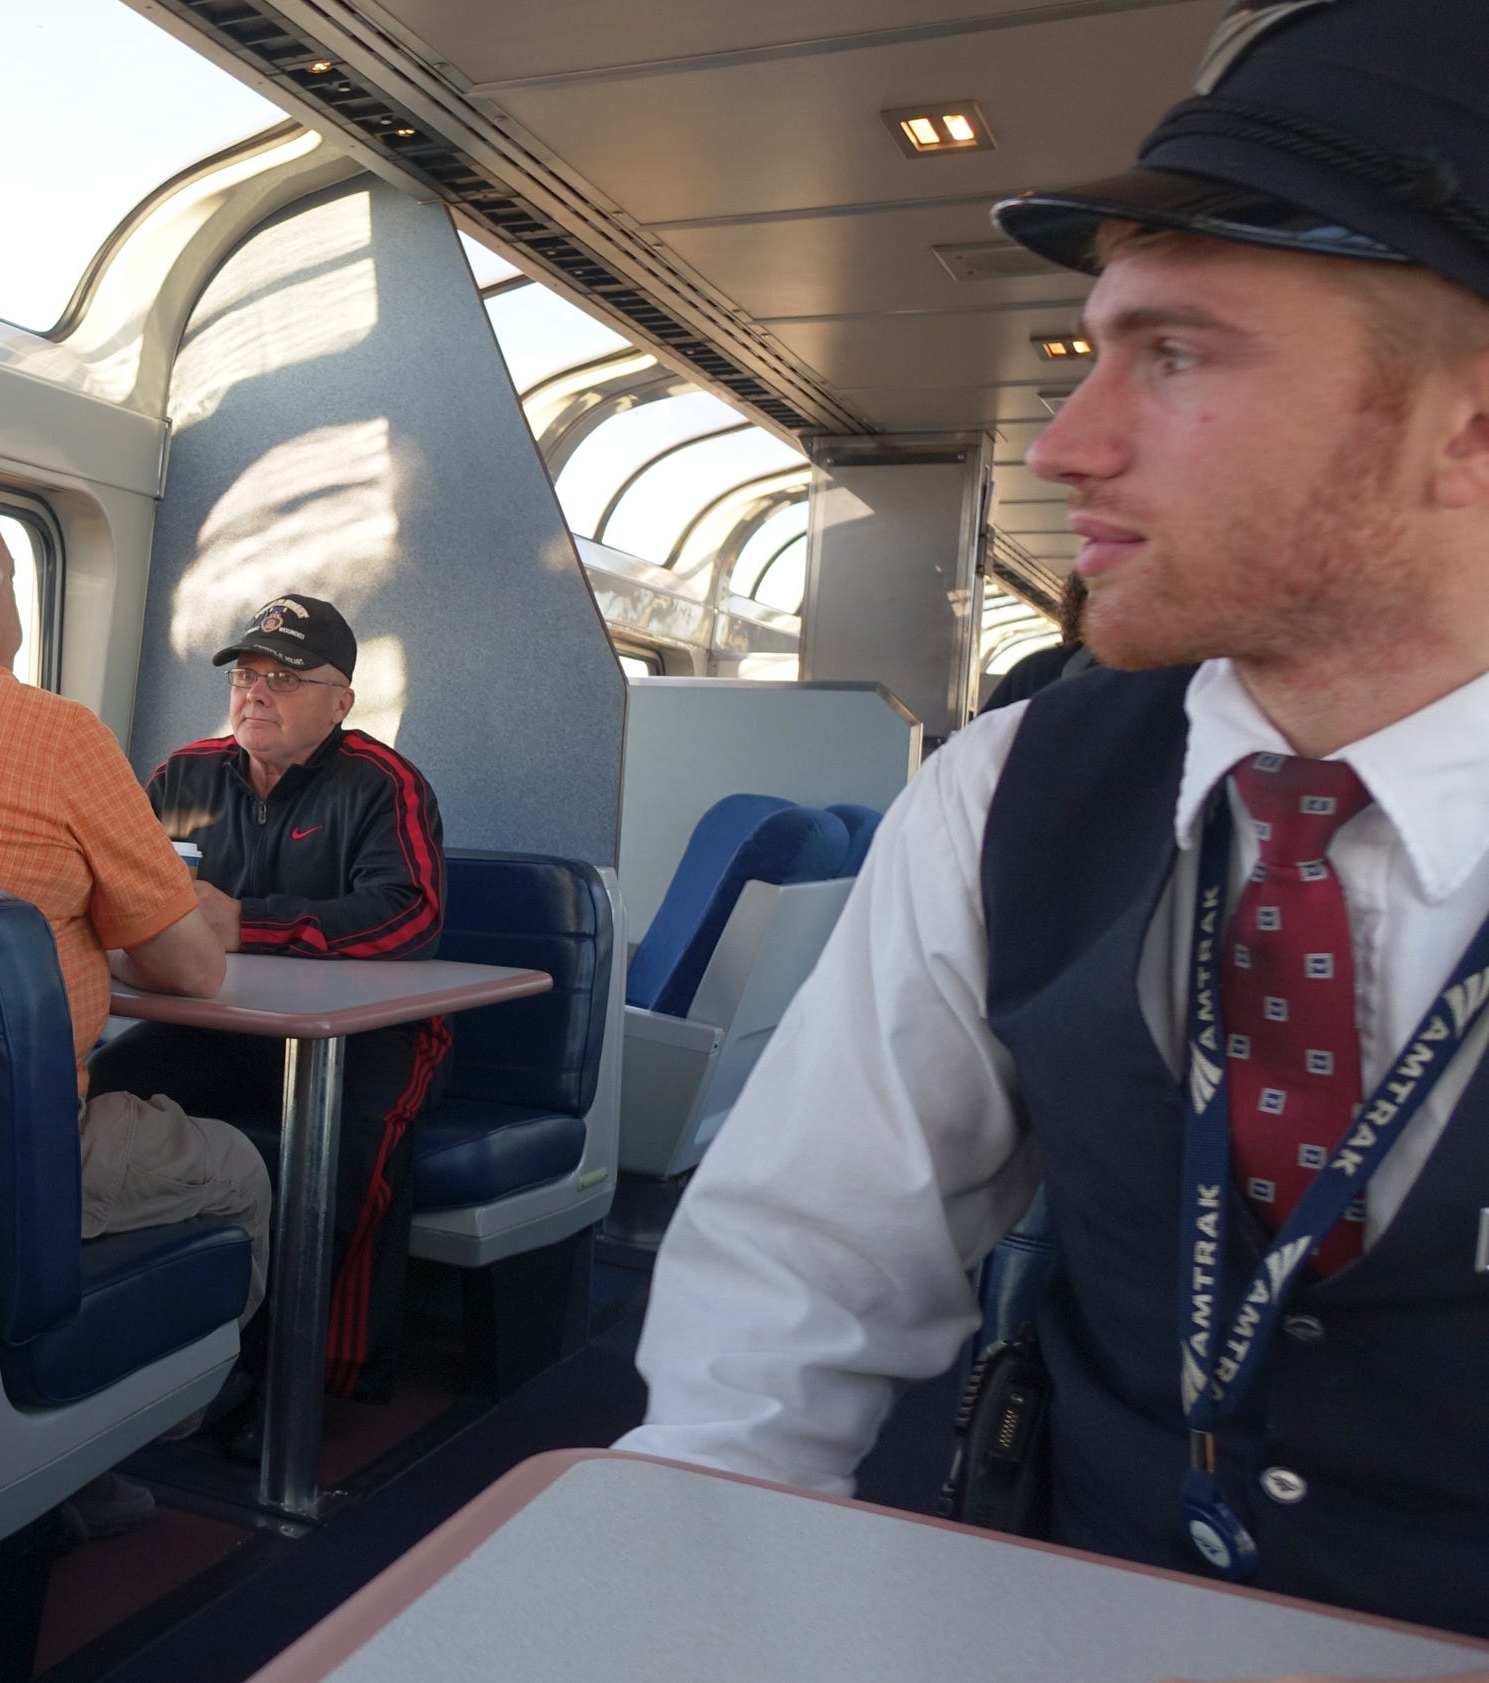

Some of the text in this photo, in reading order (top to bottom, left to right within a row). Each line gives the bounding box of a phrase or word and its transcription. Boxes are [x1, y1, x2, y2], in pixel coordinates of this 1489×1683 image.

[1197, 884, 1220, 1050] AMTRAK
[1329, 1015, 1450, 1177] AMTRAK
[1189, 1184, 1221, 1358] AMTRAK
